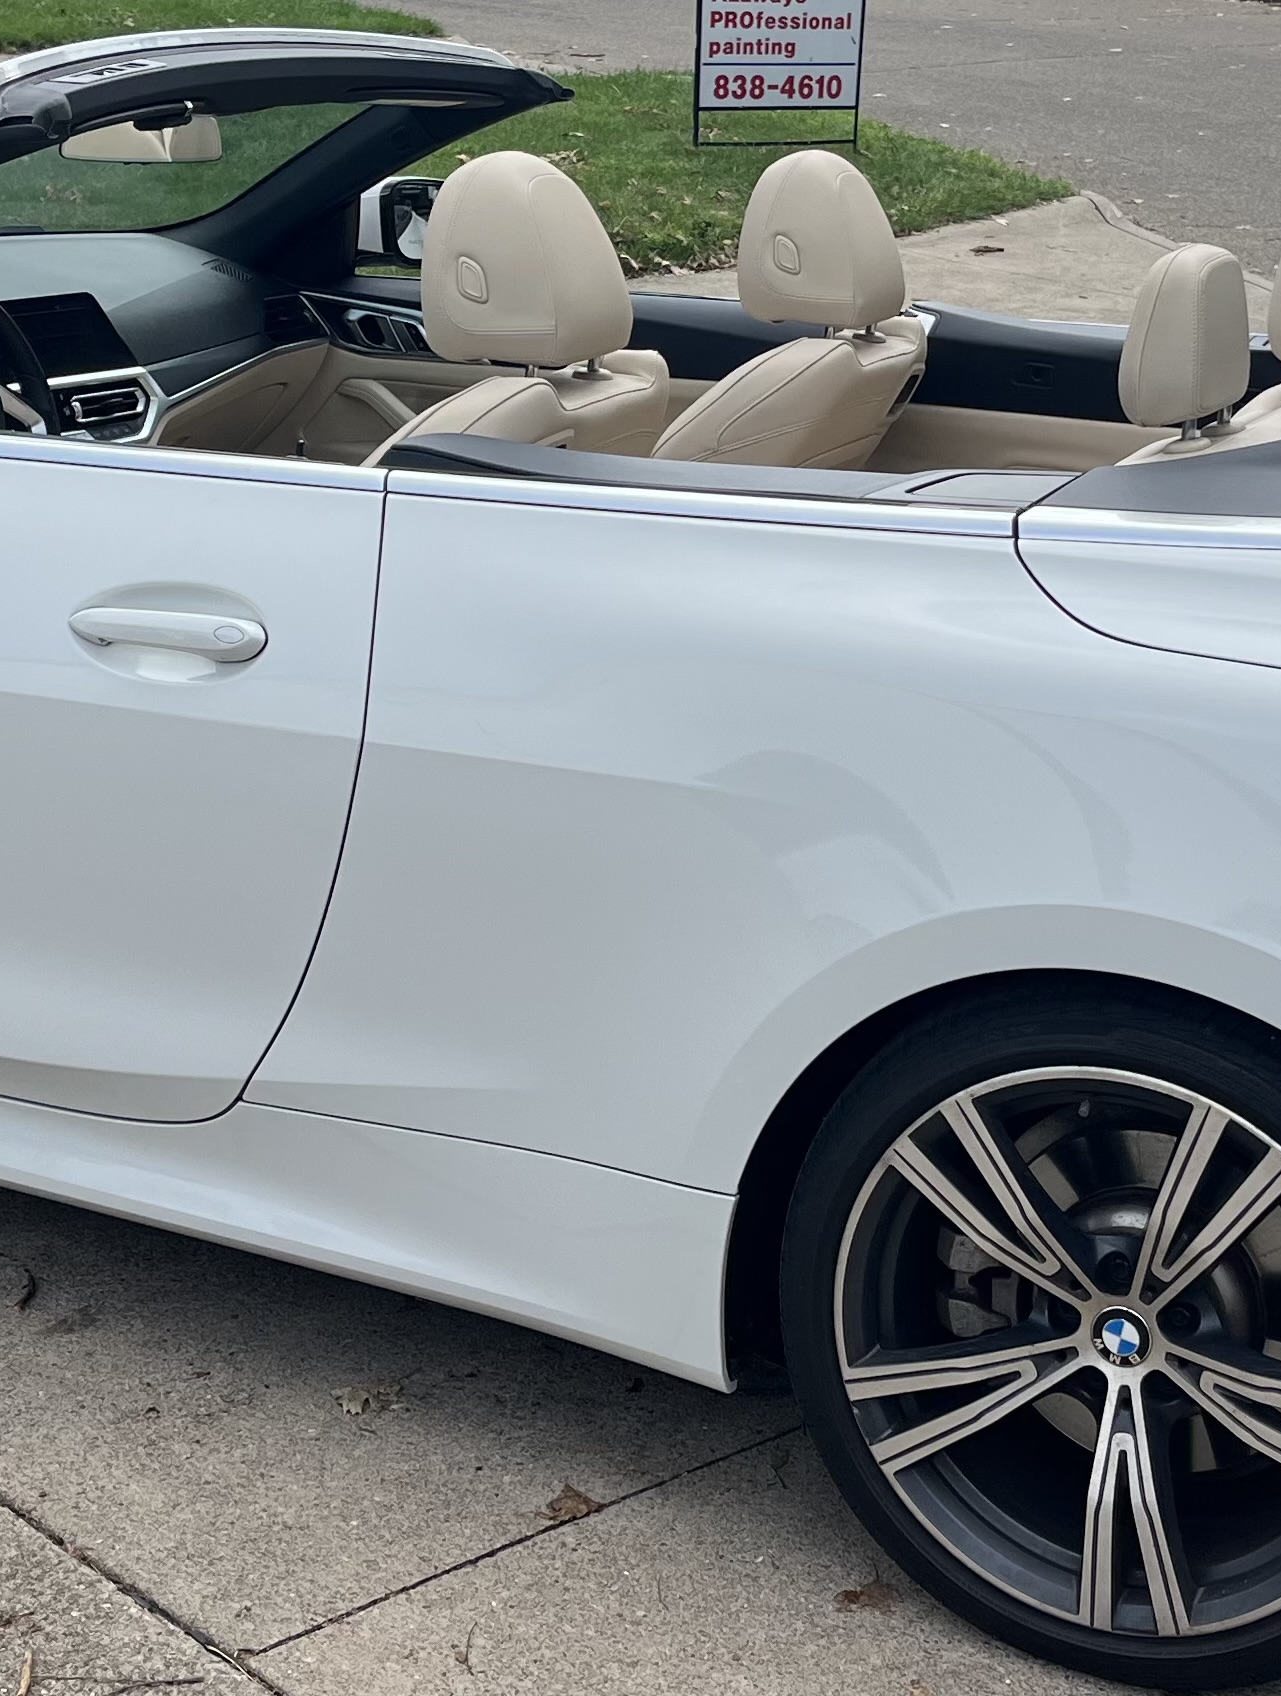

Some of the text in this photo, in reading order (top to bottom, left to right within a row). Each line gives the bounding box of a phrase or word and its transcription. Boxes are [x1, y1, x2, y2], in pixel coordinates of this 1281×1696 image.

[709, 11, 852, 30] PROfessional
[708, 37, 796, 58] painting
[713, 74, 842, 99] 838-4610
[1093, 1338, 1140, 1365] BMW
